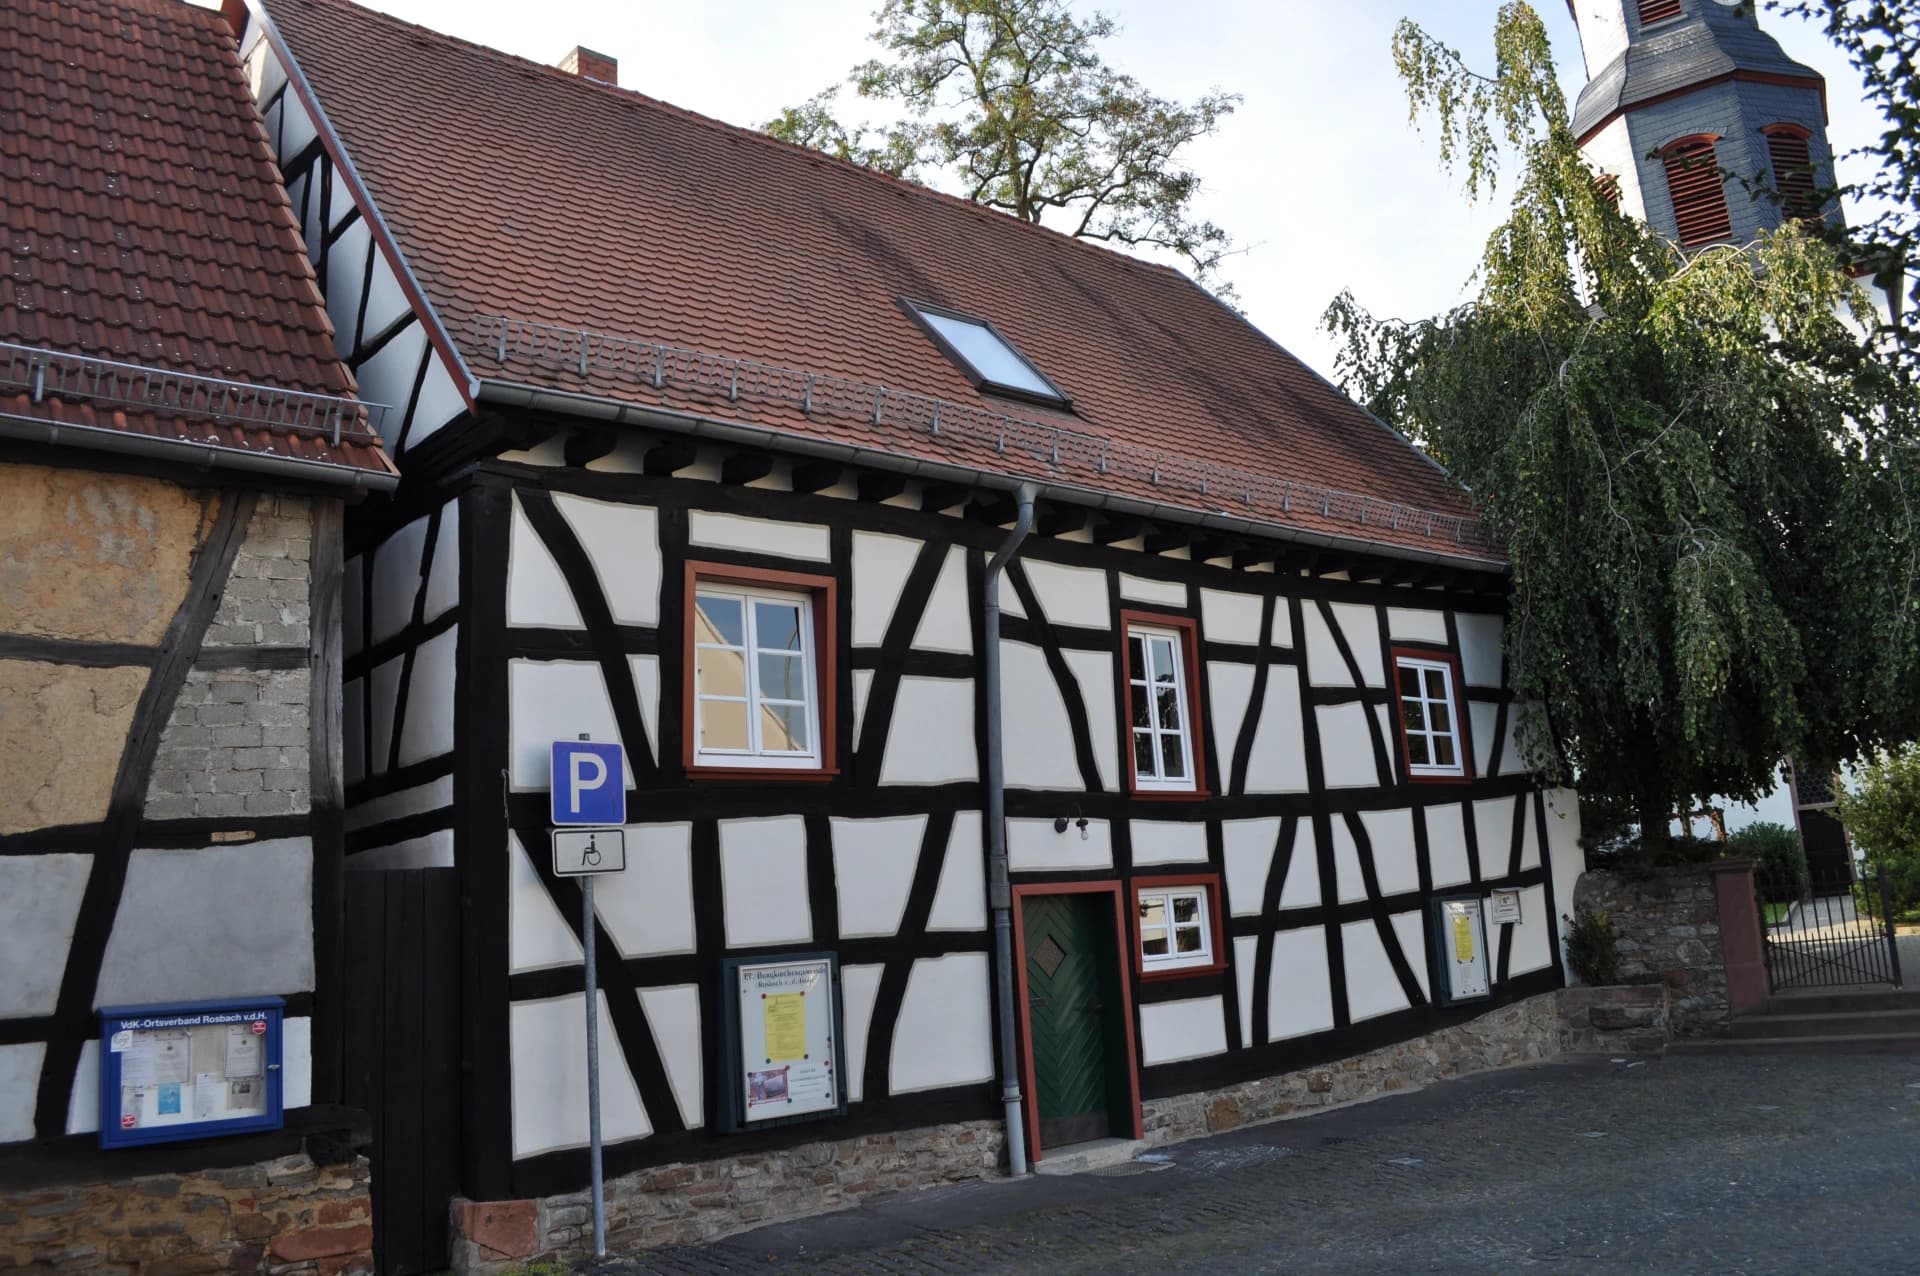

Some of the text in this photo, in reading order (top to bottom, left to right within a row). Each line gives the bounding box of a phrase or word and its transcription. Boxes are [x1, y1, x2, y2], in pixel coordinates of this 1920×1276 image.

[570, 752, 607, 813] P
[121, 1011, 268, 1029] VdK-Ortsverband Rosbach v.d.H.
